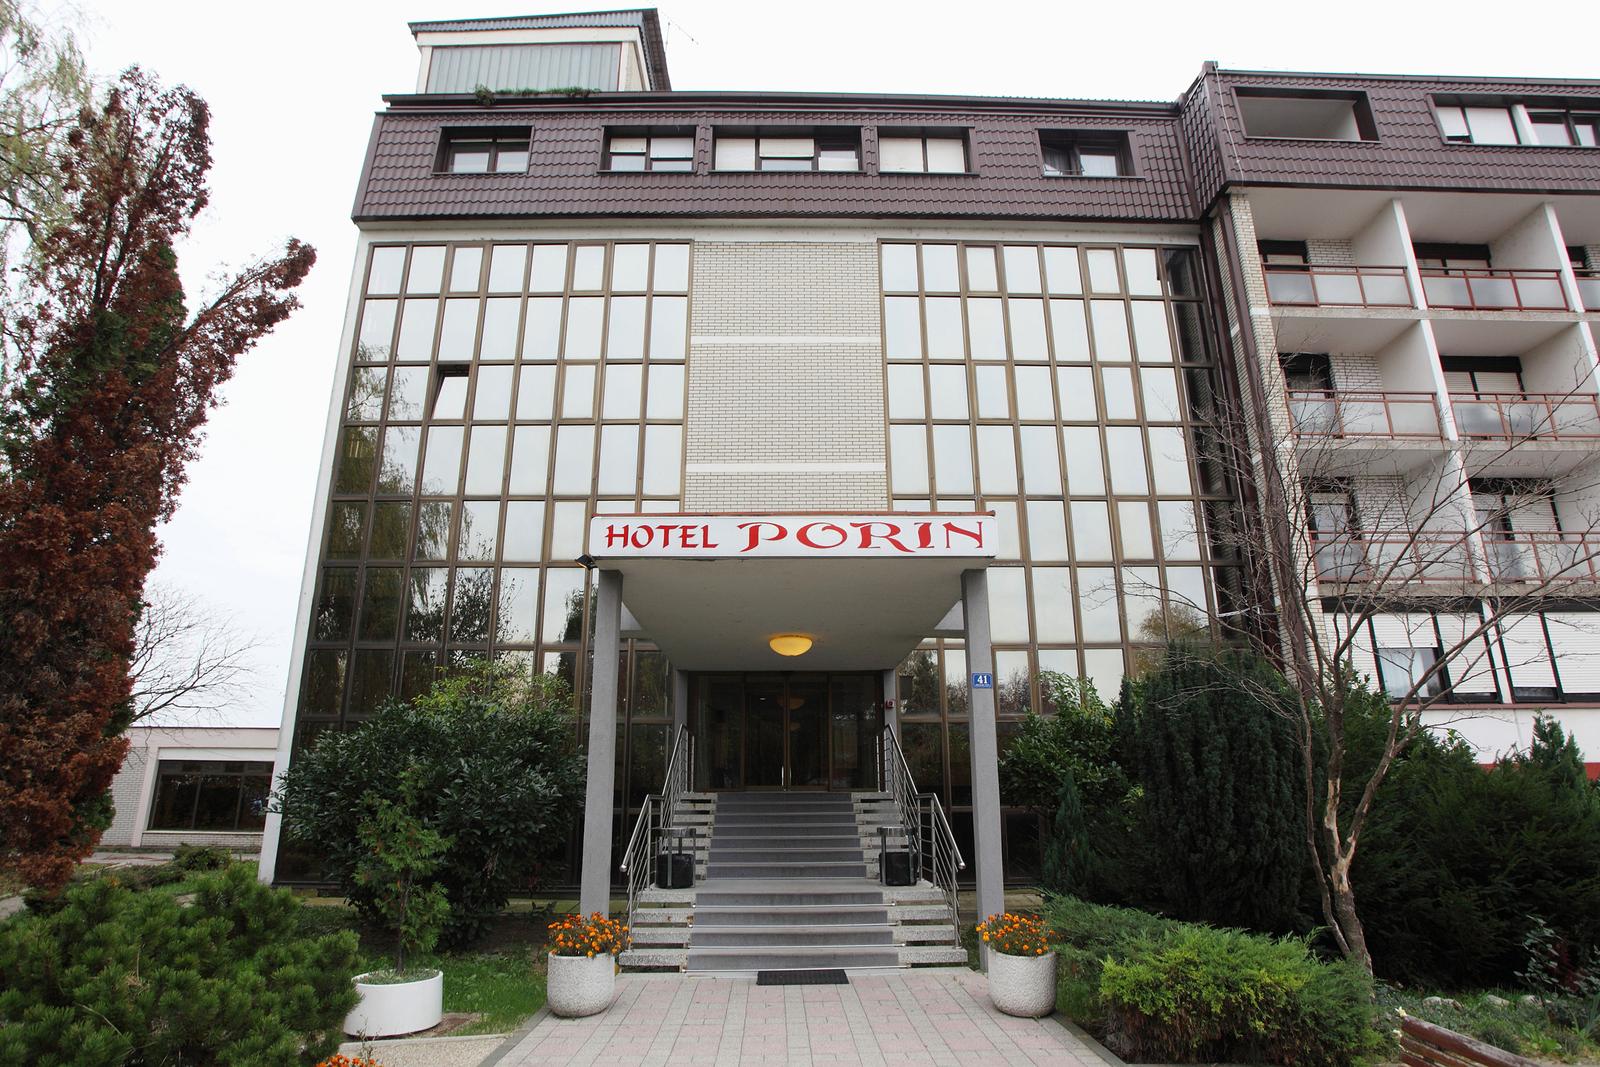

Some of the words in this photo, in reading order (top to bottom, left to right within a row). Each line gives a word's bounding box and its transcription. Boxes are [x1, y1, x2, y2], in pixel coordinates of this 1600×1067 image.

[606, 524, 719, 549] HOTEL
[737, 521, 983, 553] PORIN
[977, 675, 988, 684] 41
